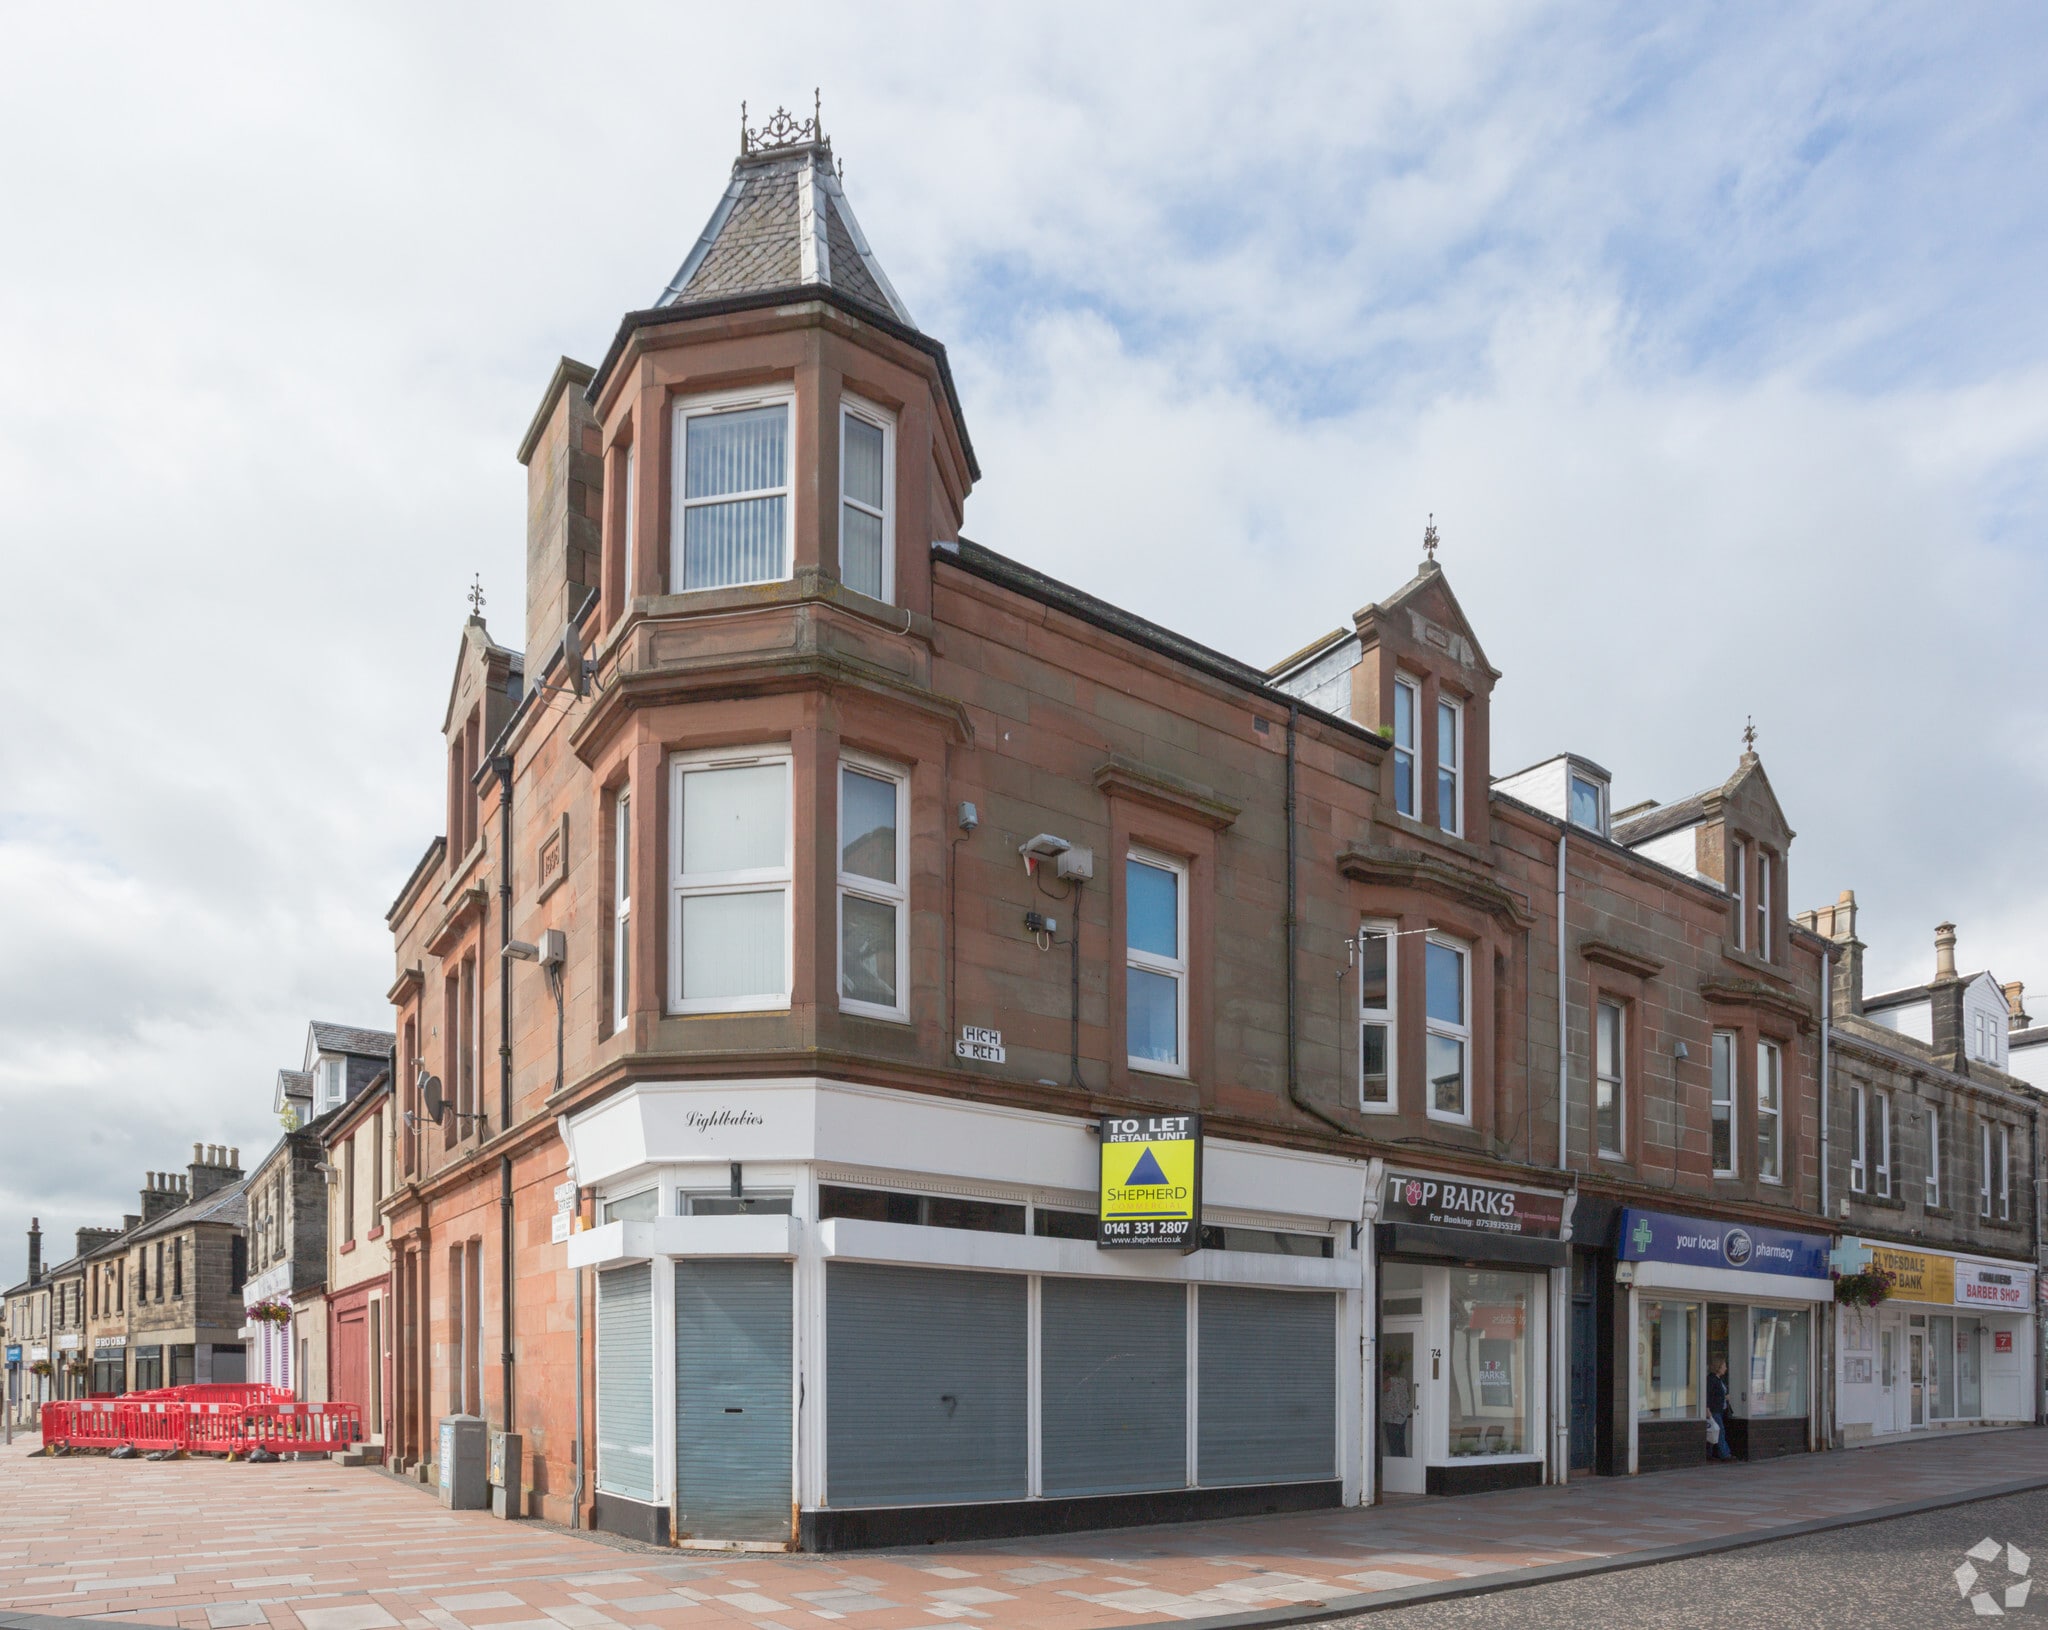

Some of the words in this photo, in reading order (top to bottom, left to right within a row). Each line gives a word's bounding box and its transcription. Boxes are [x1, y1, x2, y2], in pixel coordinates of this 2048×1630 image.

[1108, 1119, 1139, 1134] TO
[1149, 1116, 1189, 1132] LET
[1110, 1133, 1153, 1143] RETAIL
[1157, 1131, 1188, 1141] UNIT
[1107, 1186, 1187, 1201] SHEPHERD
[1441, 1184, 1515, 1217] BARKS
[1111, 1202, 1182, 1211] COMMERCIAL
[1429, 1213, 1442, 1223] For
[1104, 1222, 1130, 1235] 0141
[1134, 1222, 1154, 1234] 331
[1159, 1221, 1189, 1234] 2807
[1111, 1235, 1182, 1245] www.shepherd.co.uk
[1676, 1233, 1697, 1250] your
[1698, 1234, 1720, 1250] local
[1756, 1242, 1794, 1263] pharmacy
[1873, 1251, 1925, 1274] CLYDESDALE
[1898, 1273, 1923, 1290] BANK
[1966, 1283, 1998, 1301] BARBER
[2000, 1288, 2020, 1302] SHOP
[2000, 1338, 2007, 1346] 7
[1430, 1348, 1442, 1358] 74
[1479, 1370, 1505, 1380] BARKS
